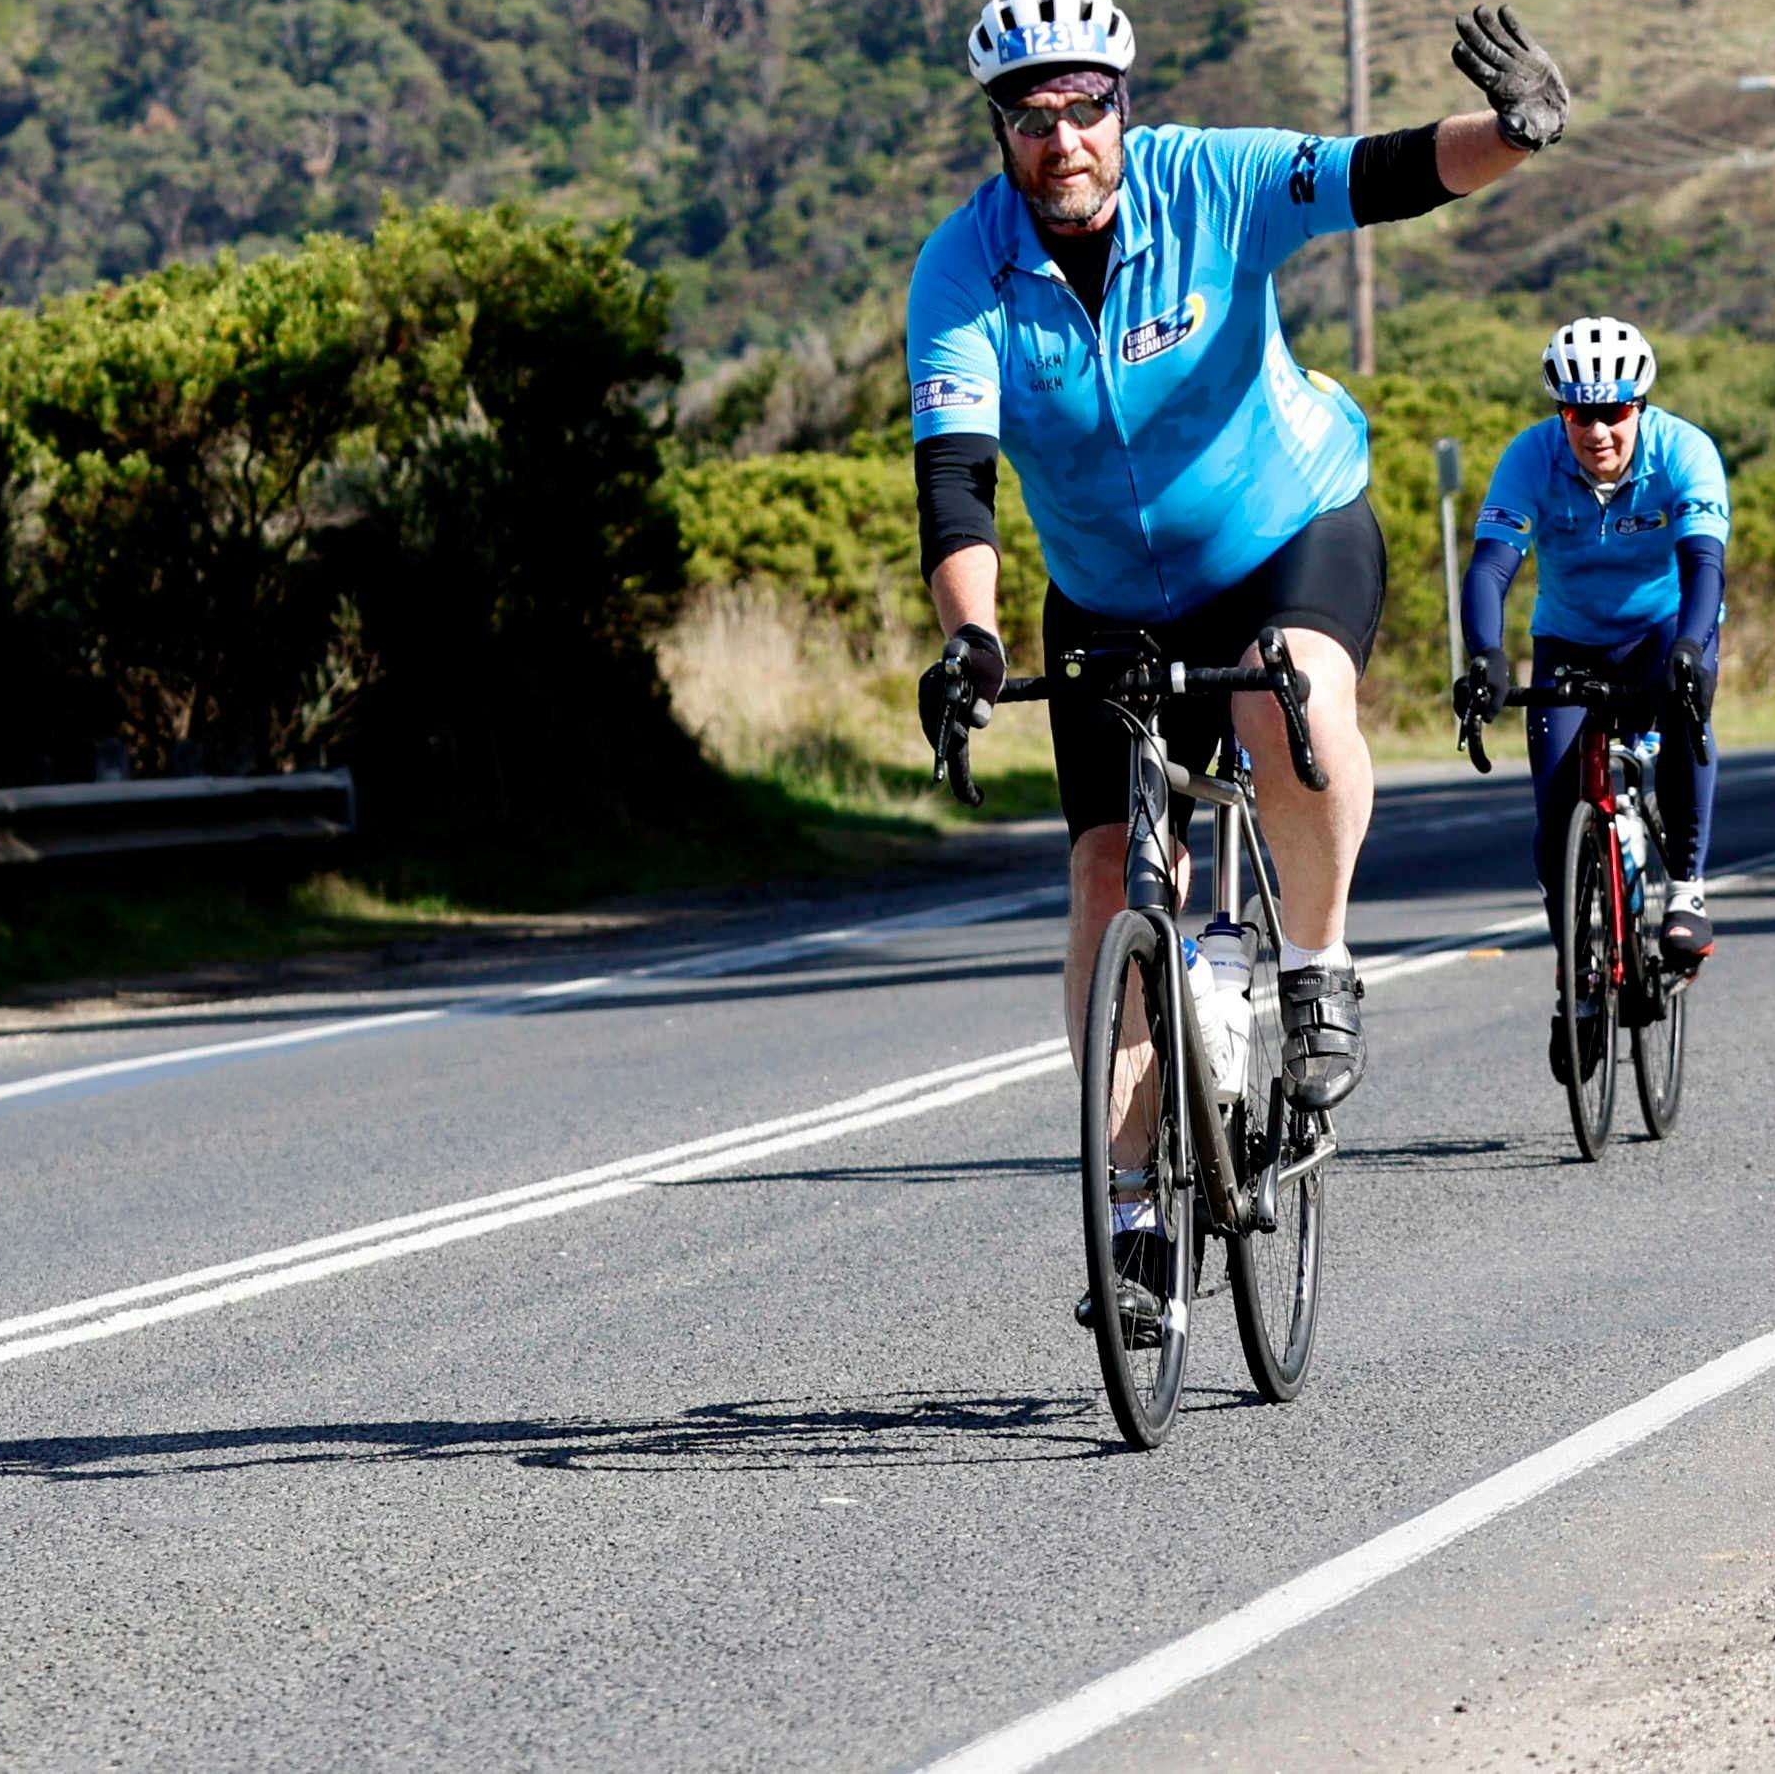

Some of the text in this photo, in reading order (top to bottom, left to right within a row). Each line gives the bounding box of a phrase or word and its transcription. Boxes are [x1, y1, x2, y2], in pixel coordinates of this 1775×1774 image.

[1127, 323, 1157, 347] GREAT
[1127, 336, 1161, 361] OCEAN
[1030, 379, 1065, 394] 60KM
[1575, 385, 1619, 404] 1322
